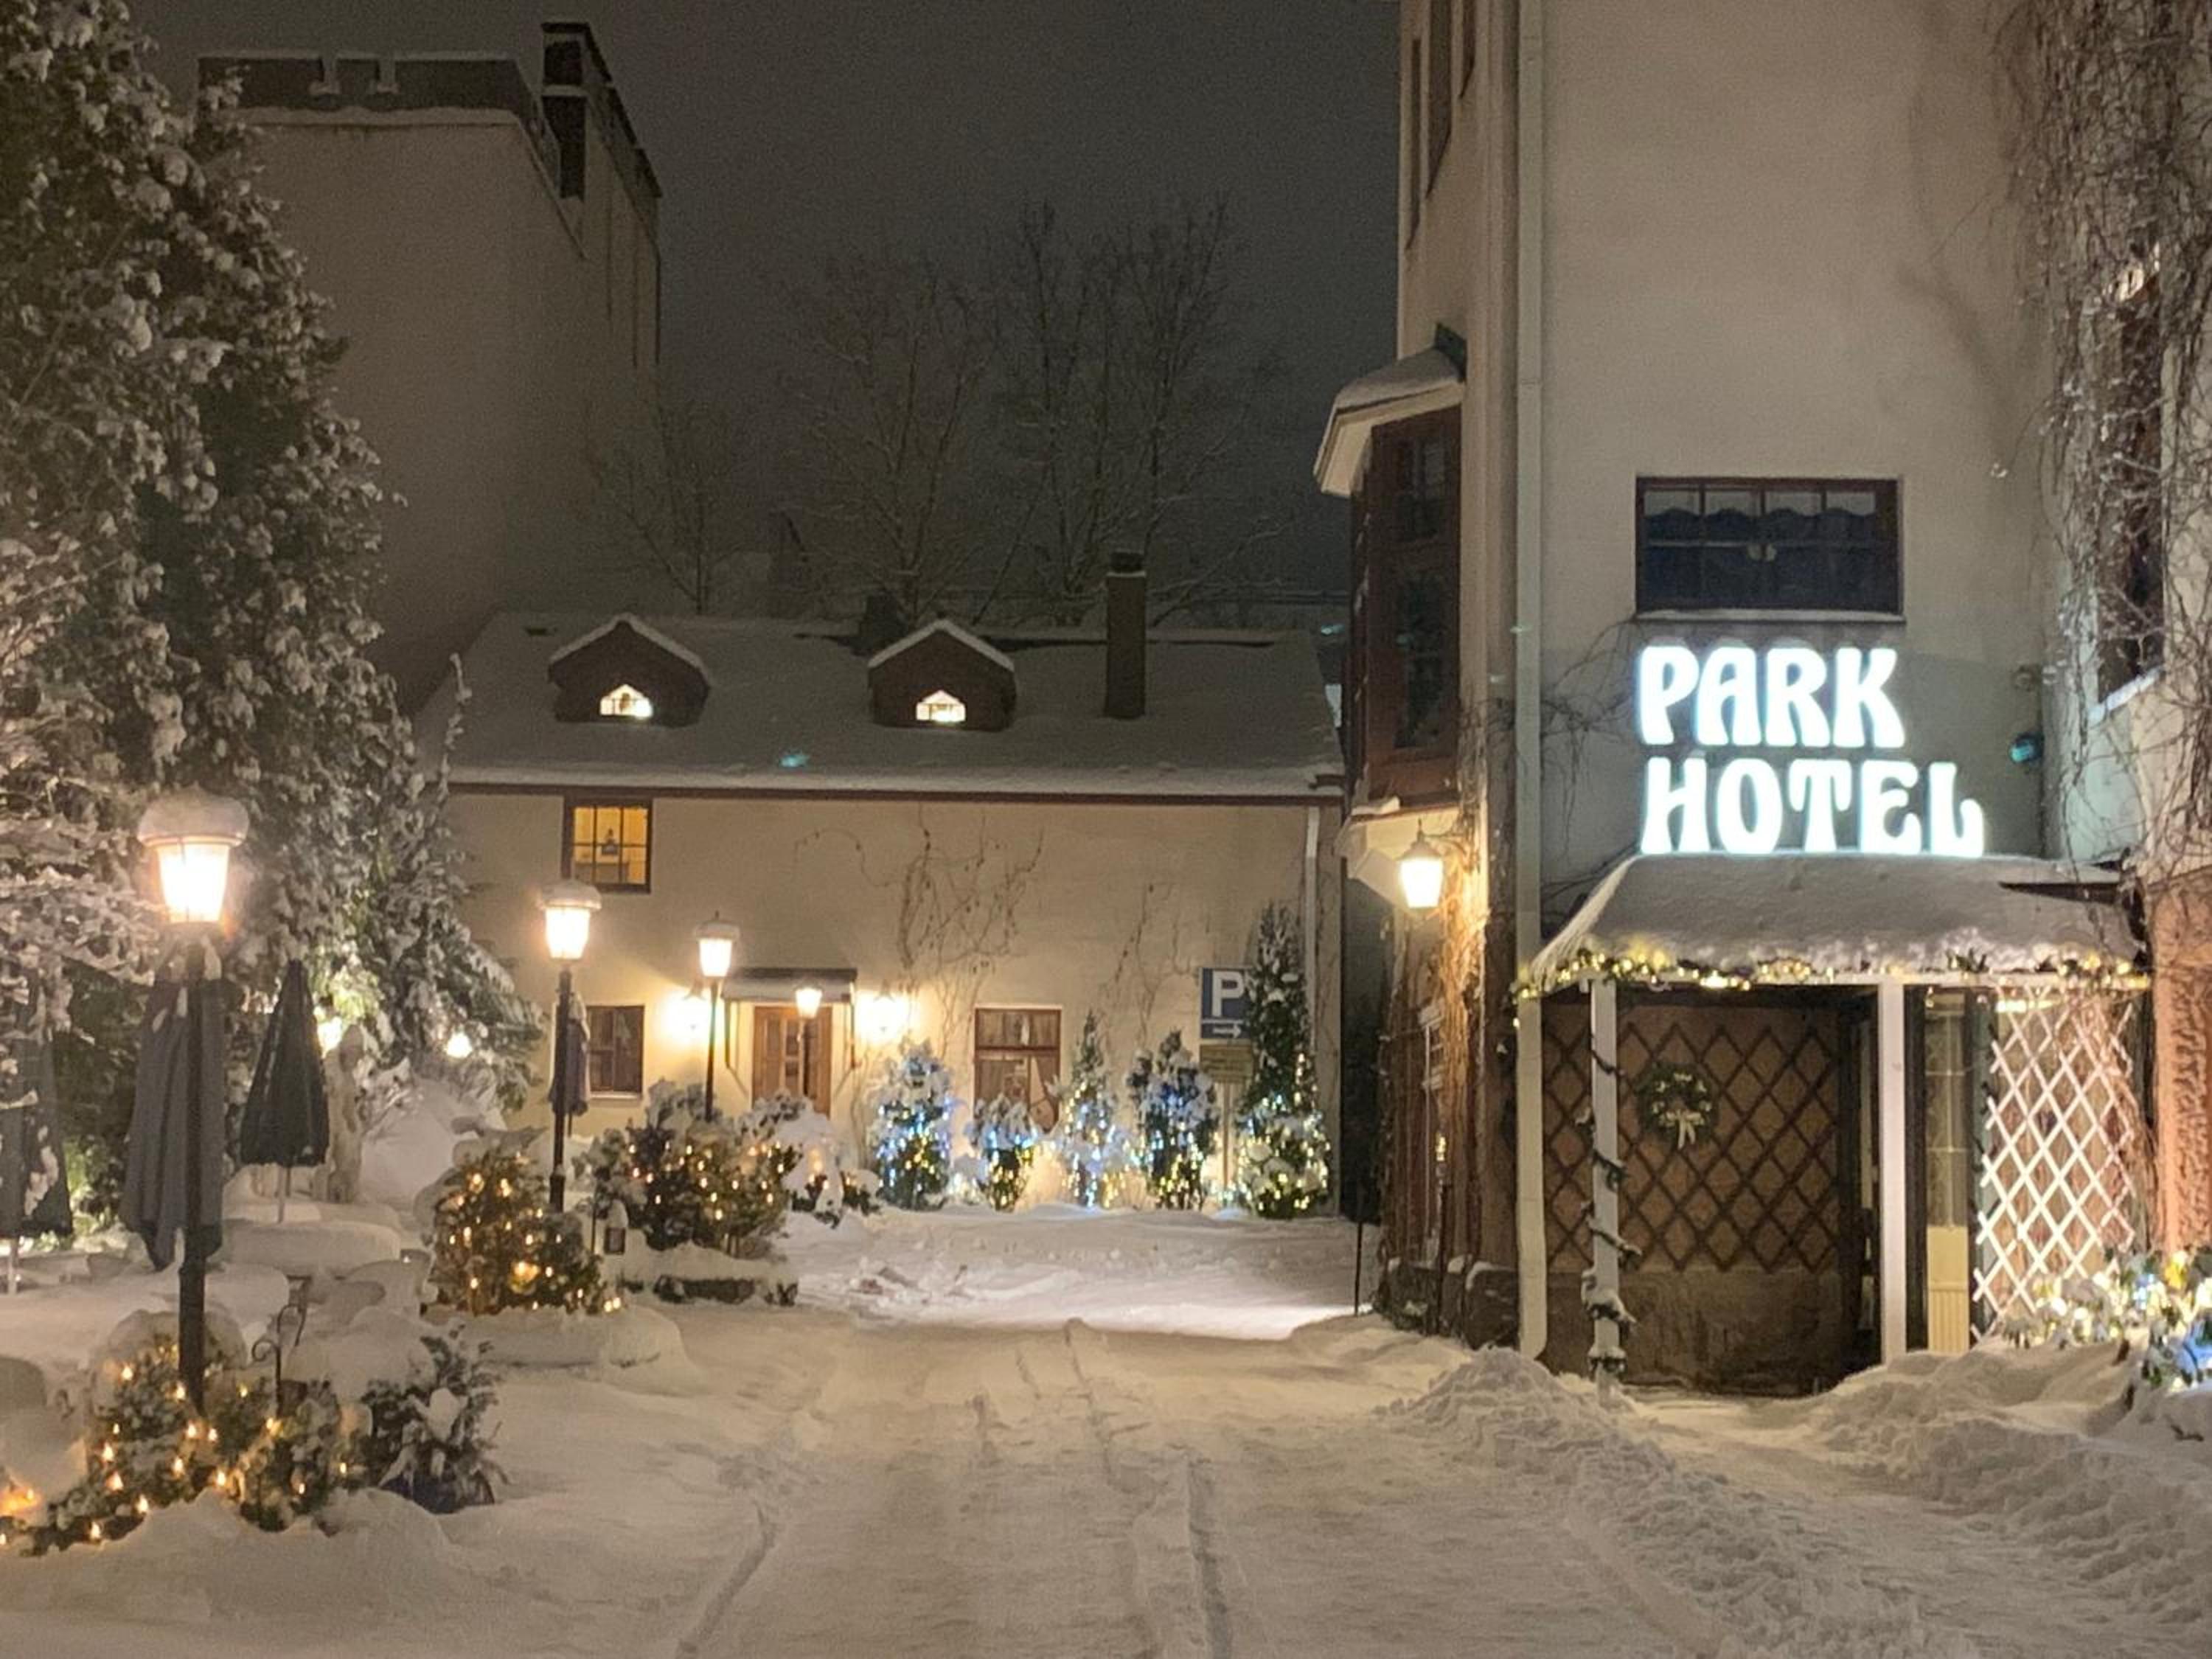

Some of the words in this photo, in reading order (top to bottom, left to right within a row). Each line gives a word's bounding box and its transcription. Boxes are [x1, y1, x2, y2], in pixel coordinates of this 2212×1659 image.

[1638, 646, 1906, 748] PARK
[1640, 757, 1985, 858] HOTEL
[1211, 970, 1245, 1018] P
